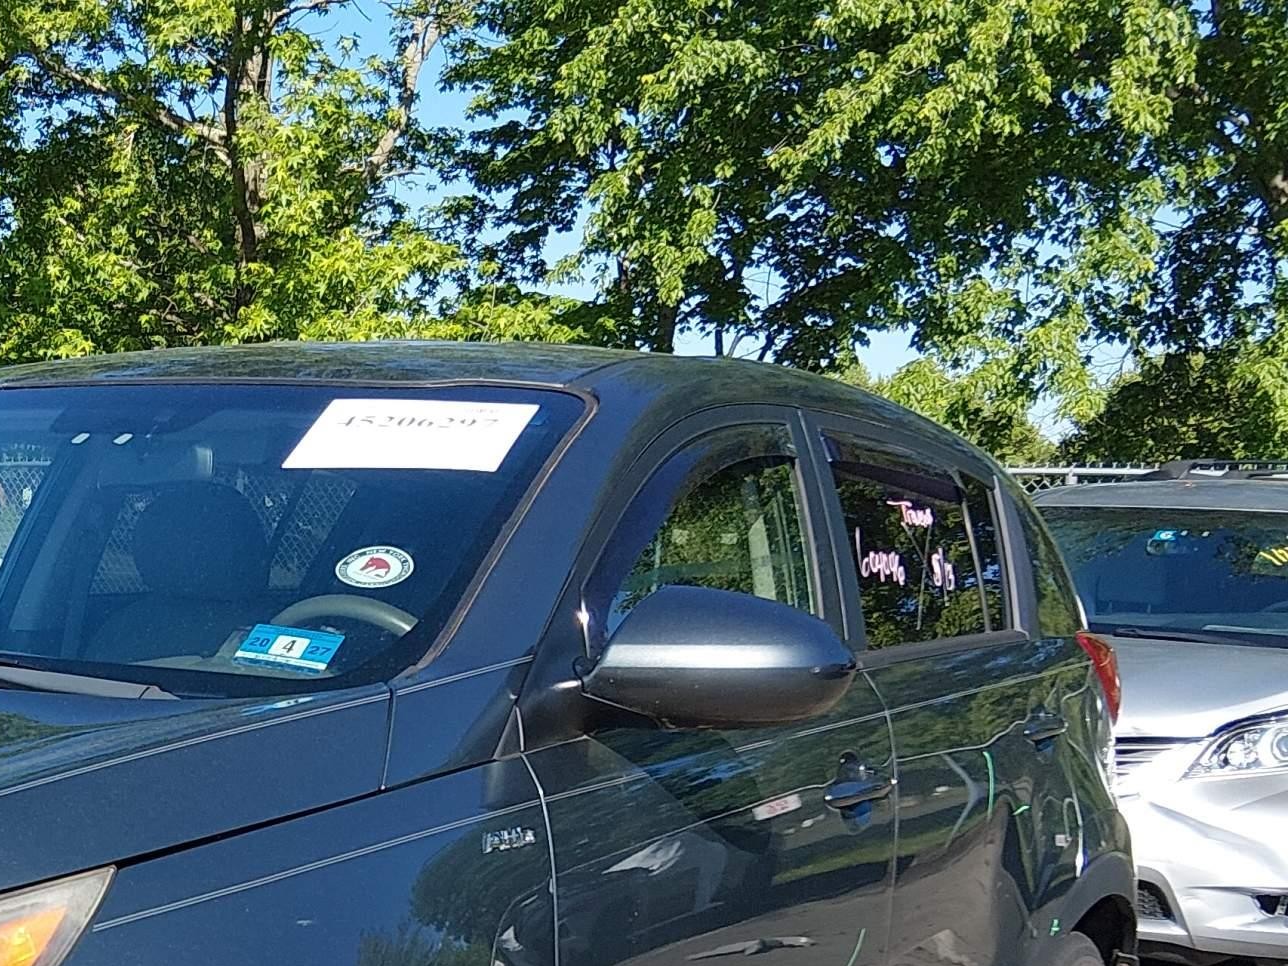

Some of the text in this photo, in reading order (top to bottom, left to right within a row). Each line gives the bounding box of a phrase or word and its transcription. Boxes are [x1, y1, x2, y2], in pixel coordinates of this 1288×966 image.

[249, 637, 332, 656] 20 4 27
